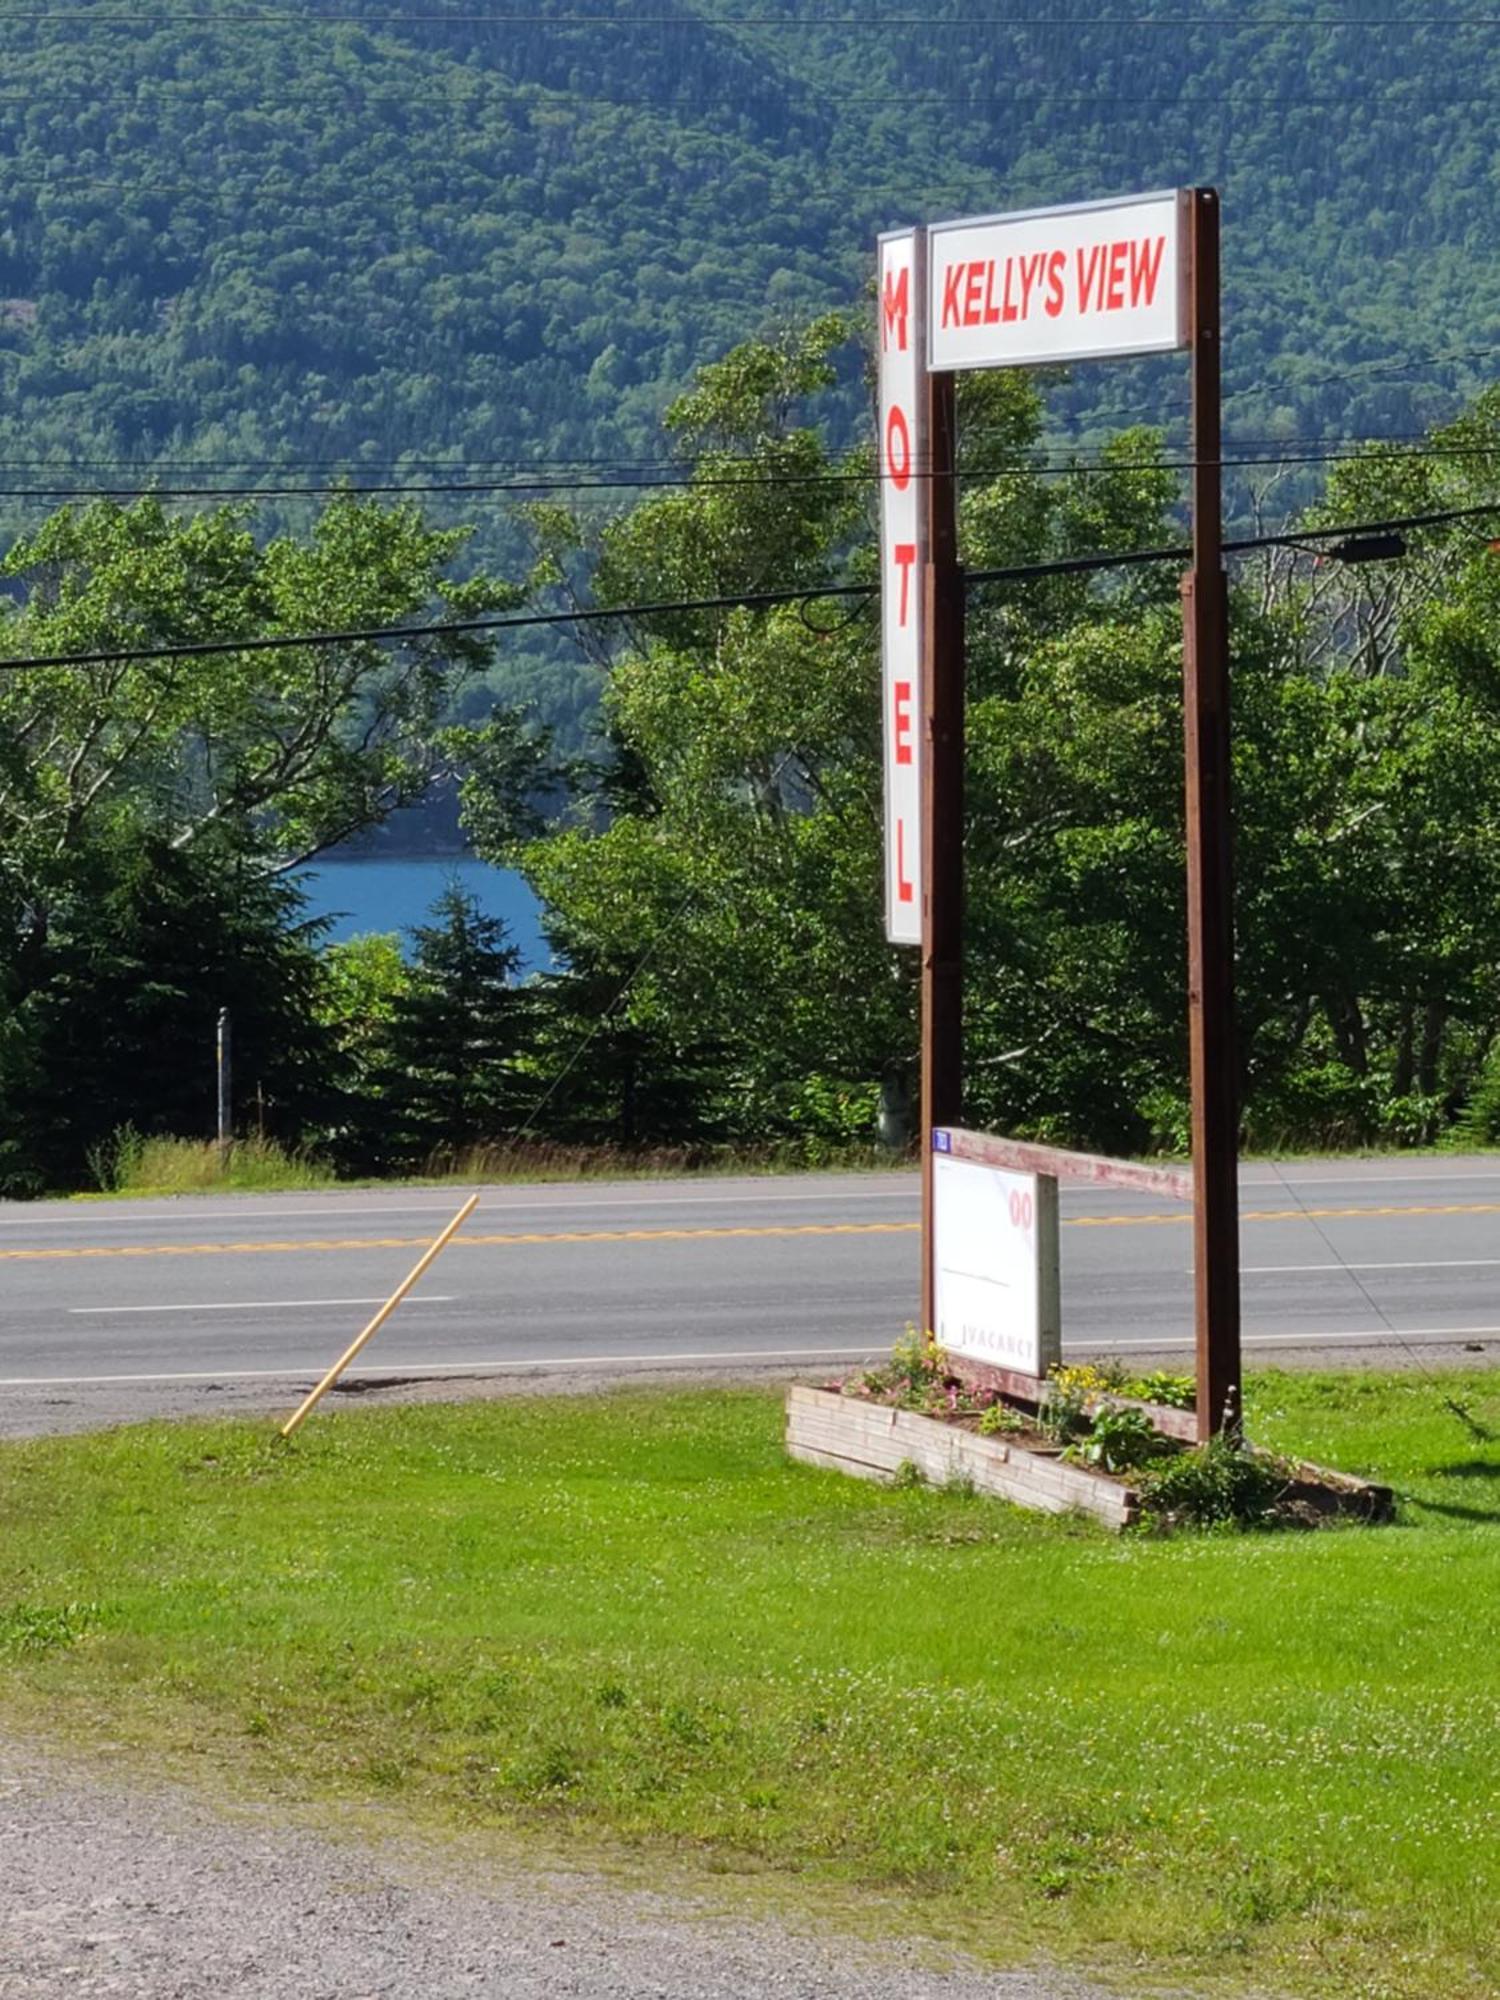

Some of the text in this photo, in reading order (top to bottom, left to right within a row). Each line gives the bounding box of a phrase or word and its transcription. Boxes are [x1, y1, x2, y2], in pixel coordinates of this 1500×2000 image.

[942, 235, 1166, 329] KELLY'S VIEW
[883, 266, 917, 903] MOTEL
[967, 1324, 1033, 1359] VACANCY
